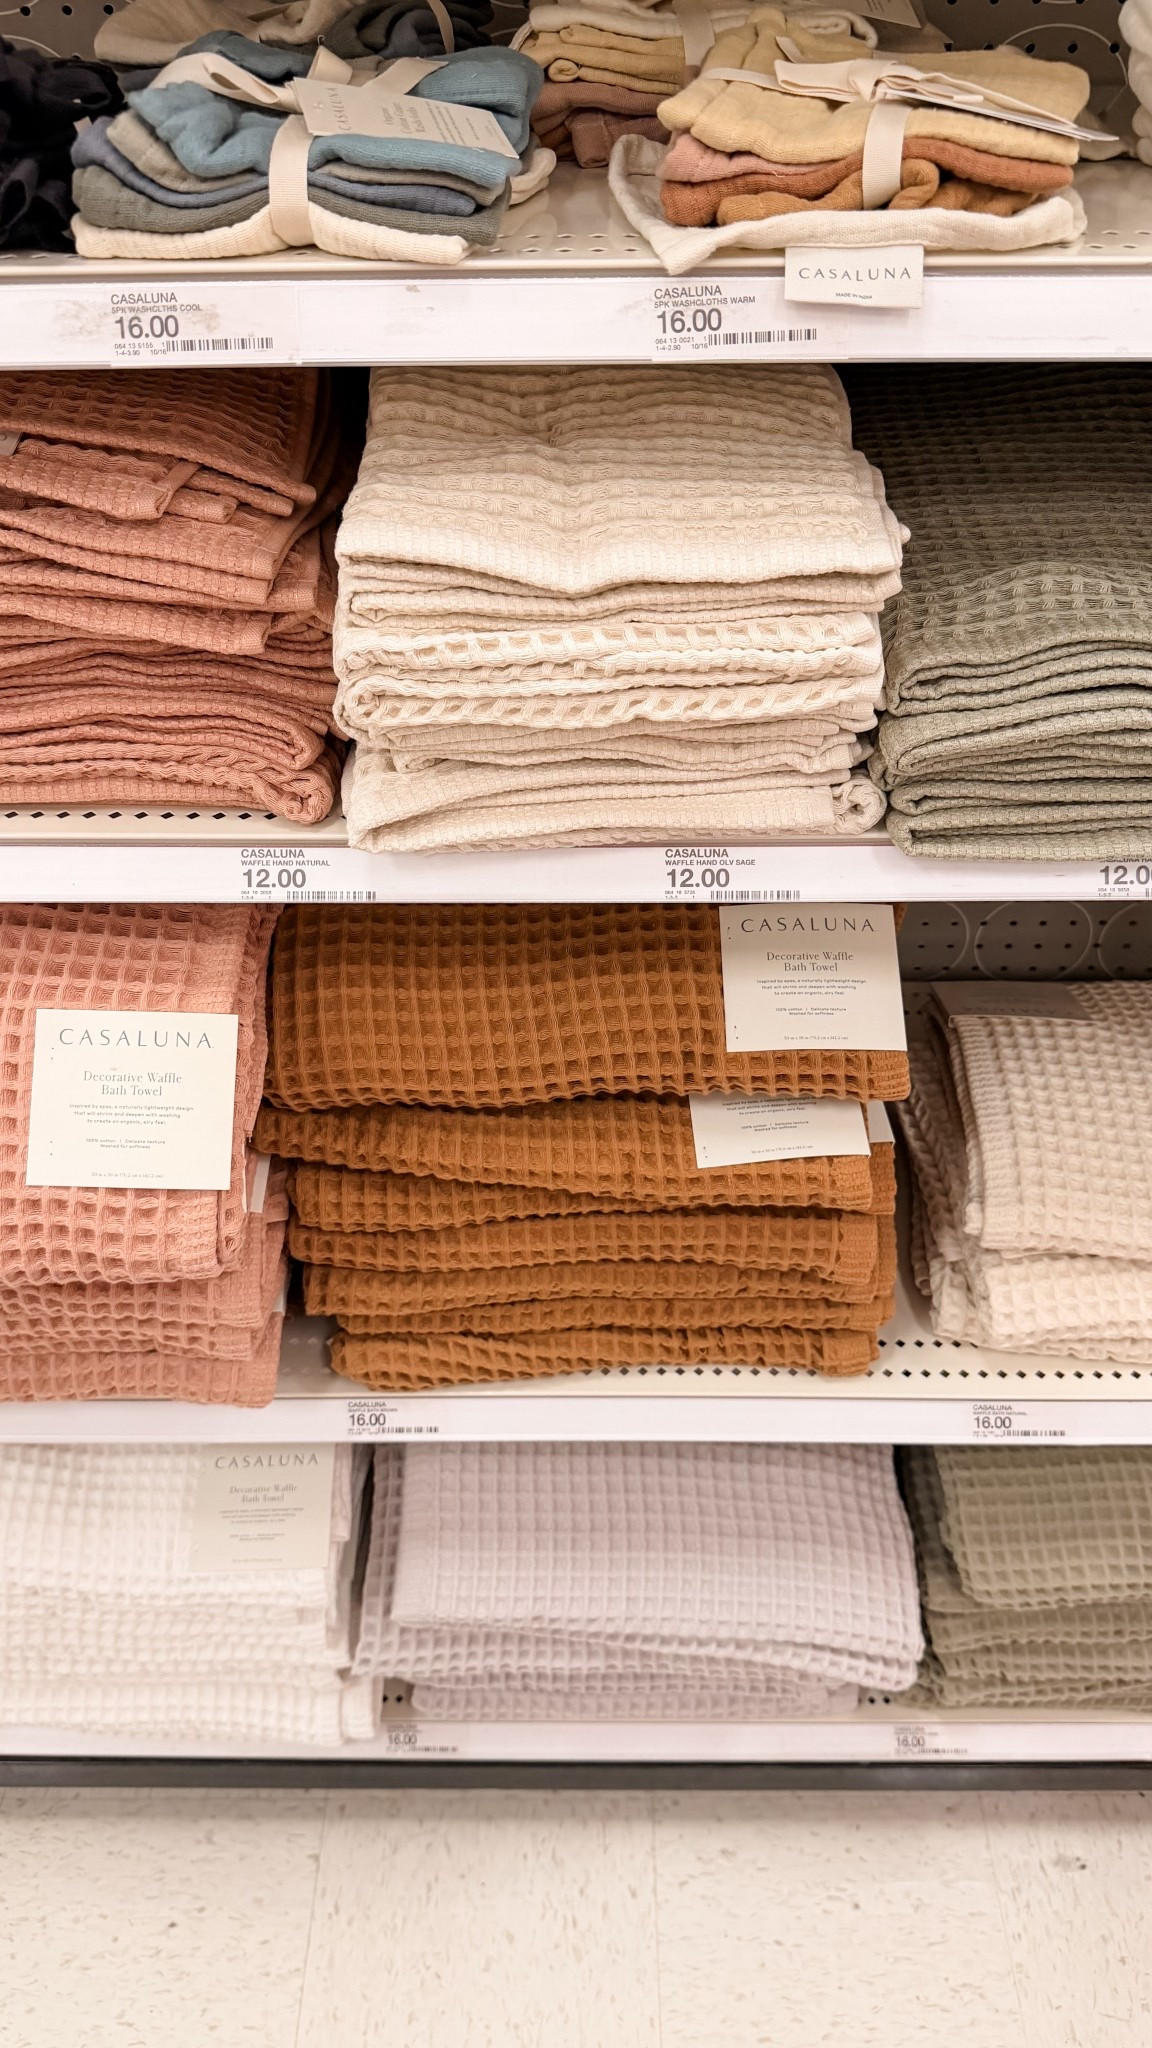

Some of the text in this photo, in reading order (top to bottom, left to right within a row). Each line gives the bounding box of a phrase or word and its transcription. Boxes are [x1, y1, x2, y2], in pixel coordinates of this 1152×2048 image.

[798, 267, 911, 282] CASALUNA
[110, 292, 178, 305] CASALUNA
[654, 286, 722, 299] CASALUNA
[180, 304, 203, 312] COOL
[654, 297, 756, 309] 5PK WASHCLOTHS WARM
[114, 314, 180, 339] 16.00
[656, 308, 722, 334] 16.00
[150, 348, 167, 356] 10/16
[241, 849, 305, 858] CASALUNA
[665, 849, 729, 858] CASALUNA
[242, 868, 307, 888] 12.00
[666, 868, 730, 888] 12.00
[1099, 865, 1152, 885] 12.0
[741, 917, 876, 933] CASALUNA
[767, 952, 854, 961] Decorative Waffle
[784, 963, 838, 972] Bath Towel
[59, 1028, 212, 1049] CASALUNA
[83, 1070, 182, 1084] Decorative Waffle
[101, 1085, 163, 1097] Bath Towel
[349, 1413, 387, 1427] 16.00
[974, 1416, 1012, 1429] 16.00
[214, 1453, 319, 1469] CASALUNA
[229, 1485, 271, 1495] Decorative
[241, 1495, 260, 1503] Bath
